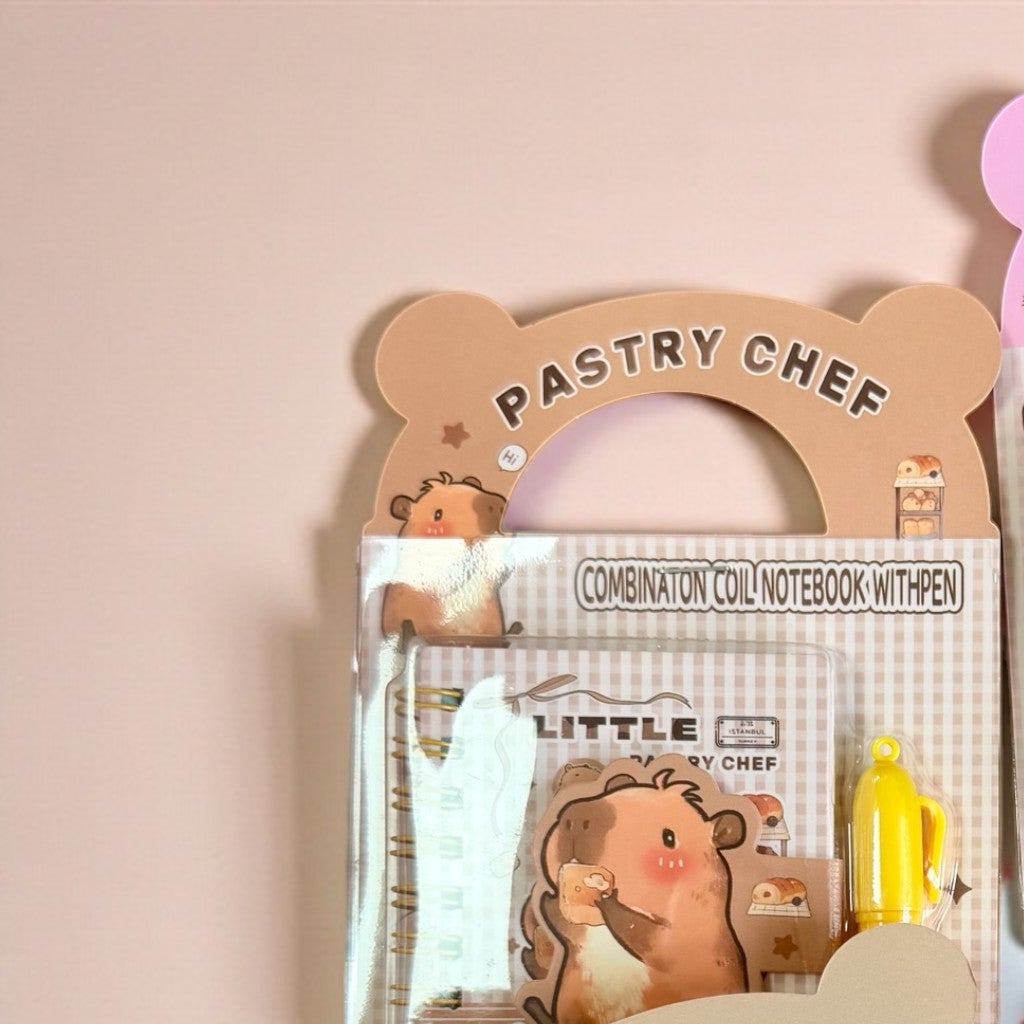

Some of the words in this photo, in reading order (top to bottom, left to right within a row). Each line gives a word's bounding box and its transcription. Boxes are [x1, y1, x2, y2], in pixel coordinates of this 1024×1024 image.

[496, 328, 725, 430] PASTRY
[743, 335, 890, 418] CHEF
[502, 449, 520, 466] Hi
[582, 565, 707, 604] COMBINATON
[713, 567, 755, 605] COIL
[761, 568, 866, 606] NOTEBOOK
[873, 568, 957, 607] WITHPEN
[533, 715, 698, 741] LITTLE
[721, 755, 777, 771] CHEF
